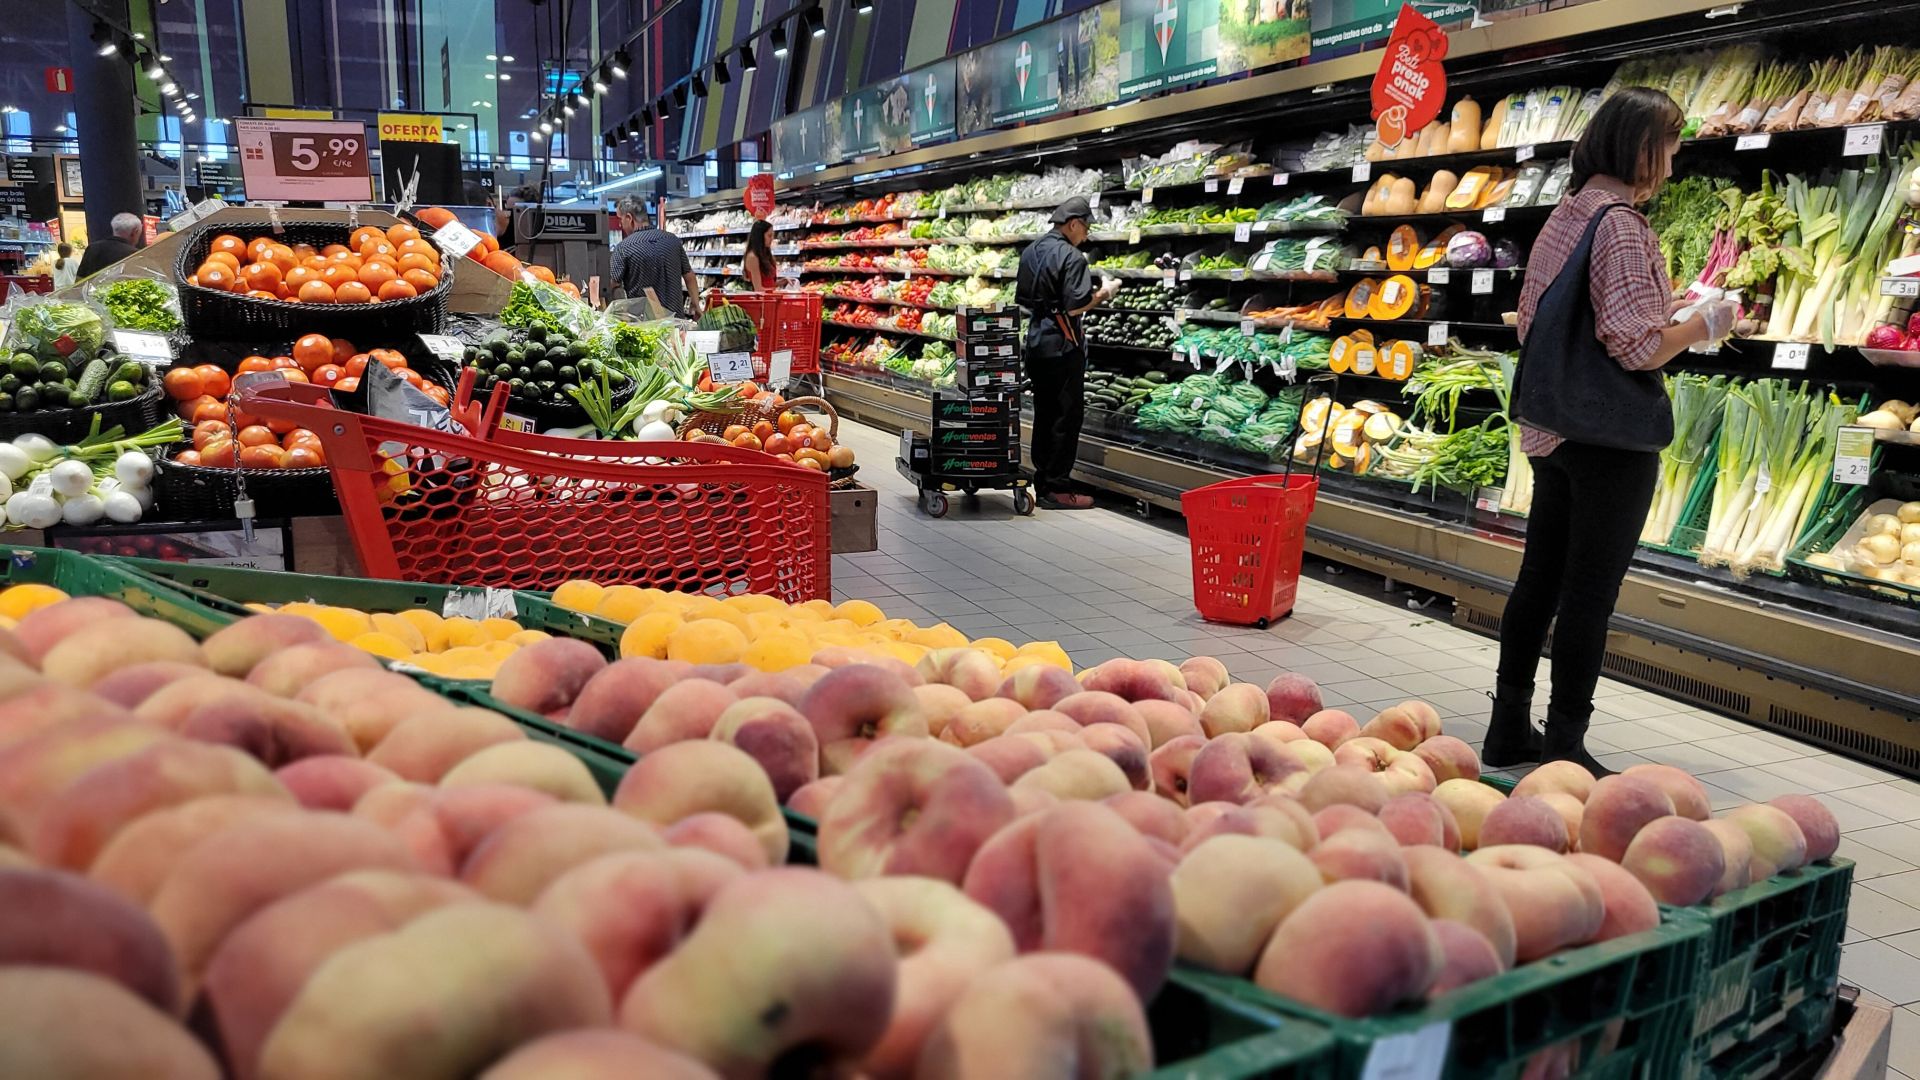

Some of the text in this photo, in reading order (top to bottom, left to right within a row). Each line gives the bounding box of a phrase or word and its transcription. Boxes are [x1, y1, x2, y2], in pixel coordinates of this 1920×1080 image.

[1396, 44, 1419, 69] Beti
[1392, 61, 1429, 88] prezio
[1394, 75, 1426, 101] onak
[382, 124, 439, 136] OFERTA
[291, 137, 360, 171] 5,99
[546, 215, 586, 227] DIBAL
[728, 359, 748, 371] 2,21
